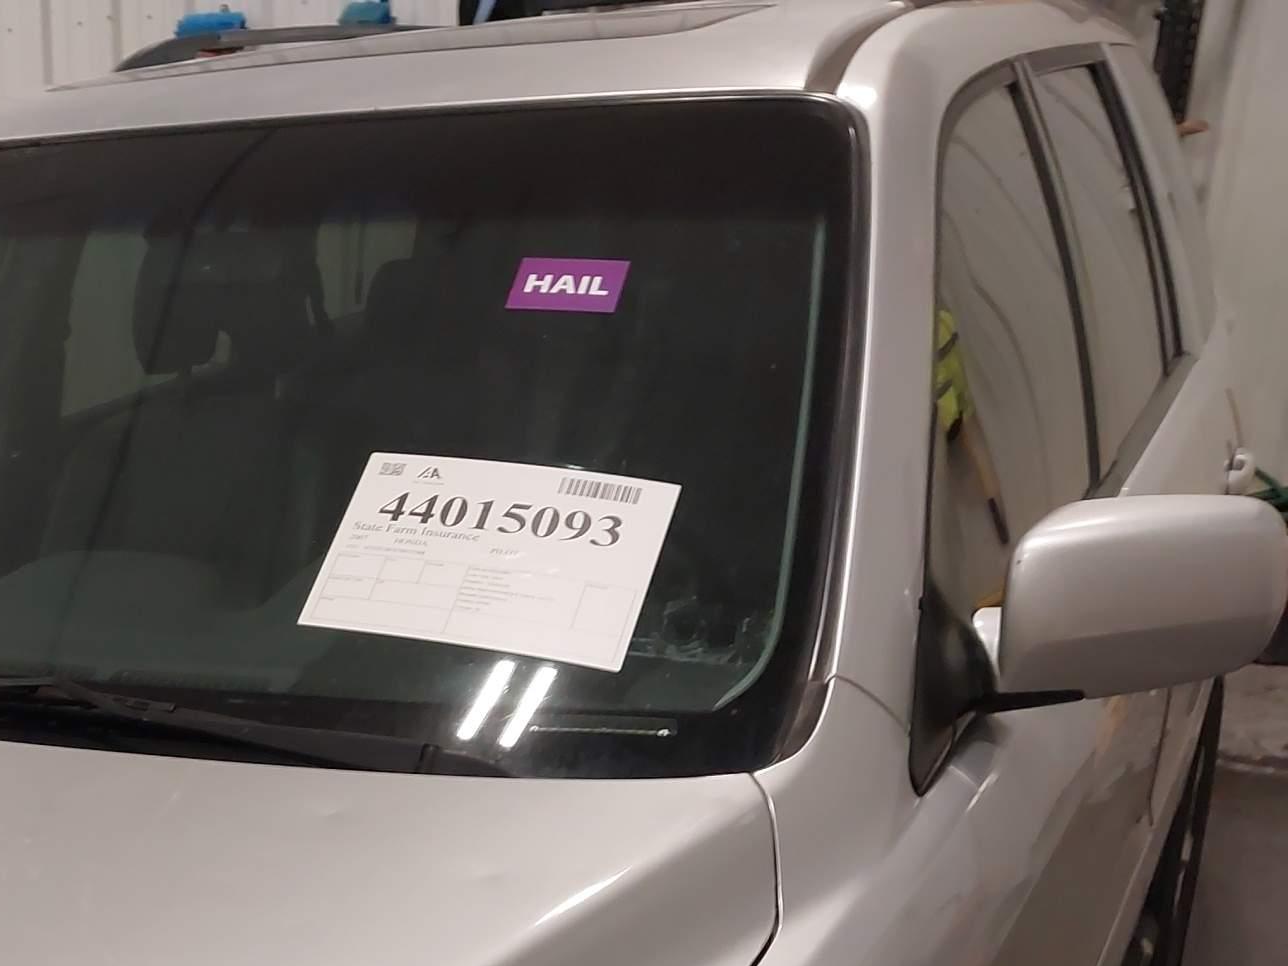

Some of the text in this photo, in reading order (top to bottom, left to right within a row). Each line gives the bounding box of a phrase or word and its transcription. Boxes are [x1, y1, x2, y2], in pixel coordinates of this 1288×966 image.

[523, 273, 609, 296] HAIL
[378, 491, 623, 547] 44015093
[352, 521, 481, 542] State Farm Insurance
